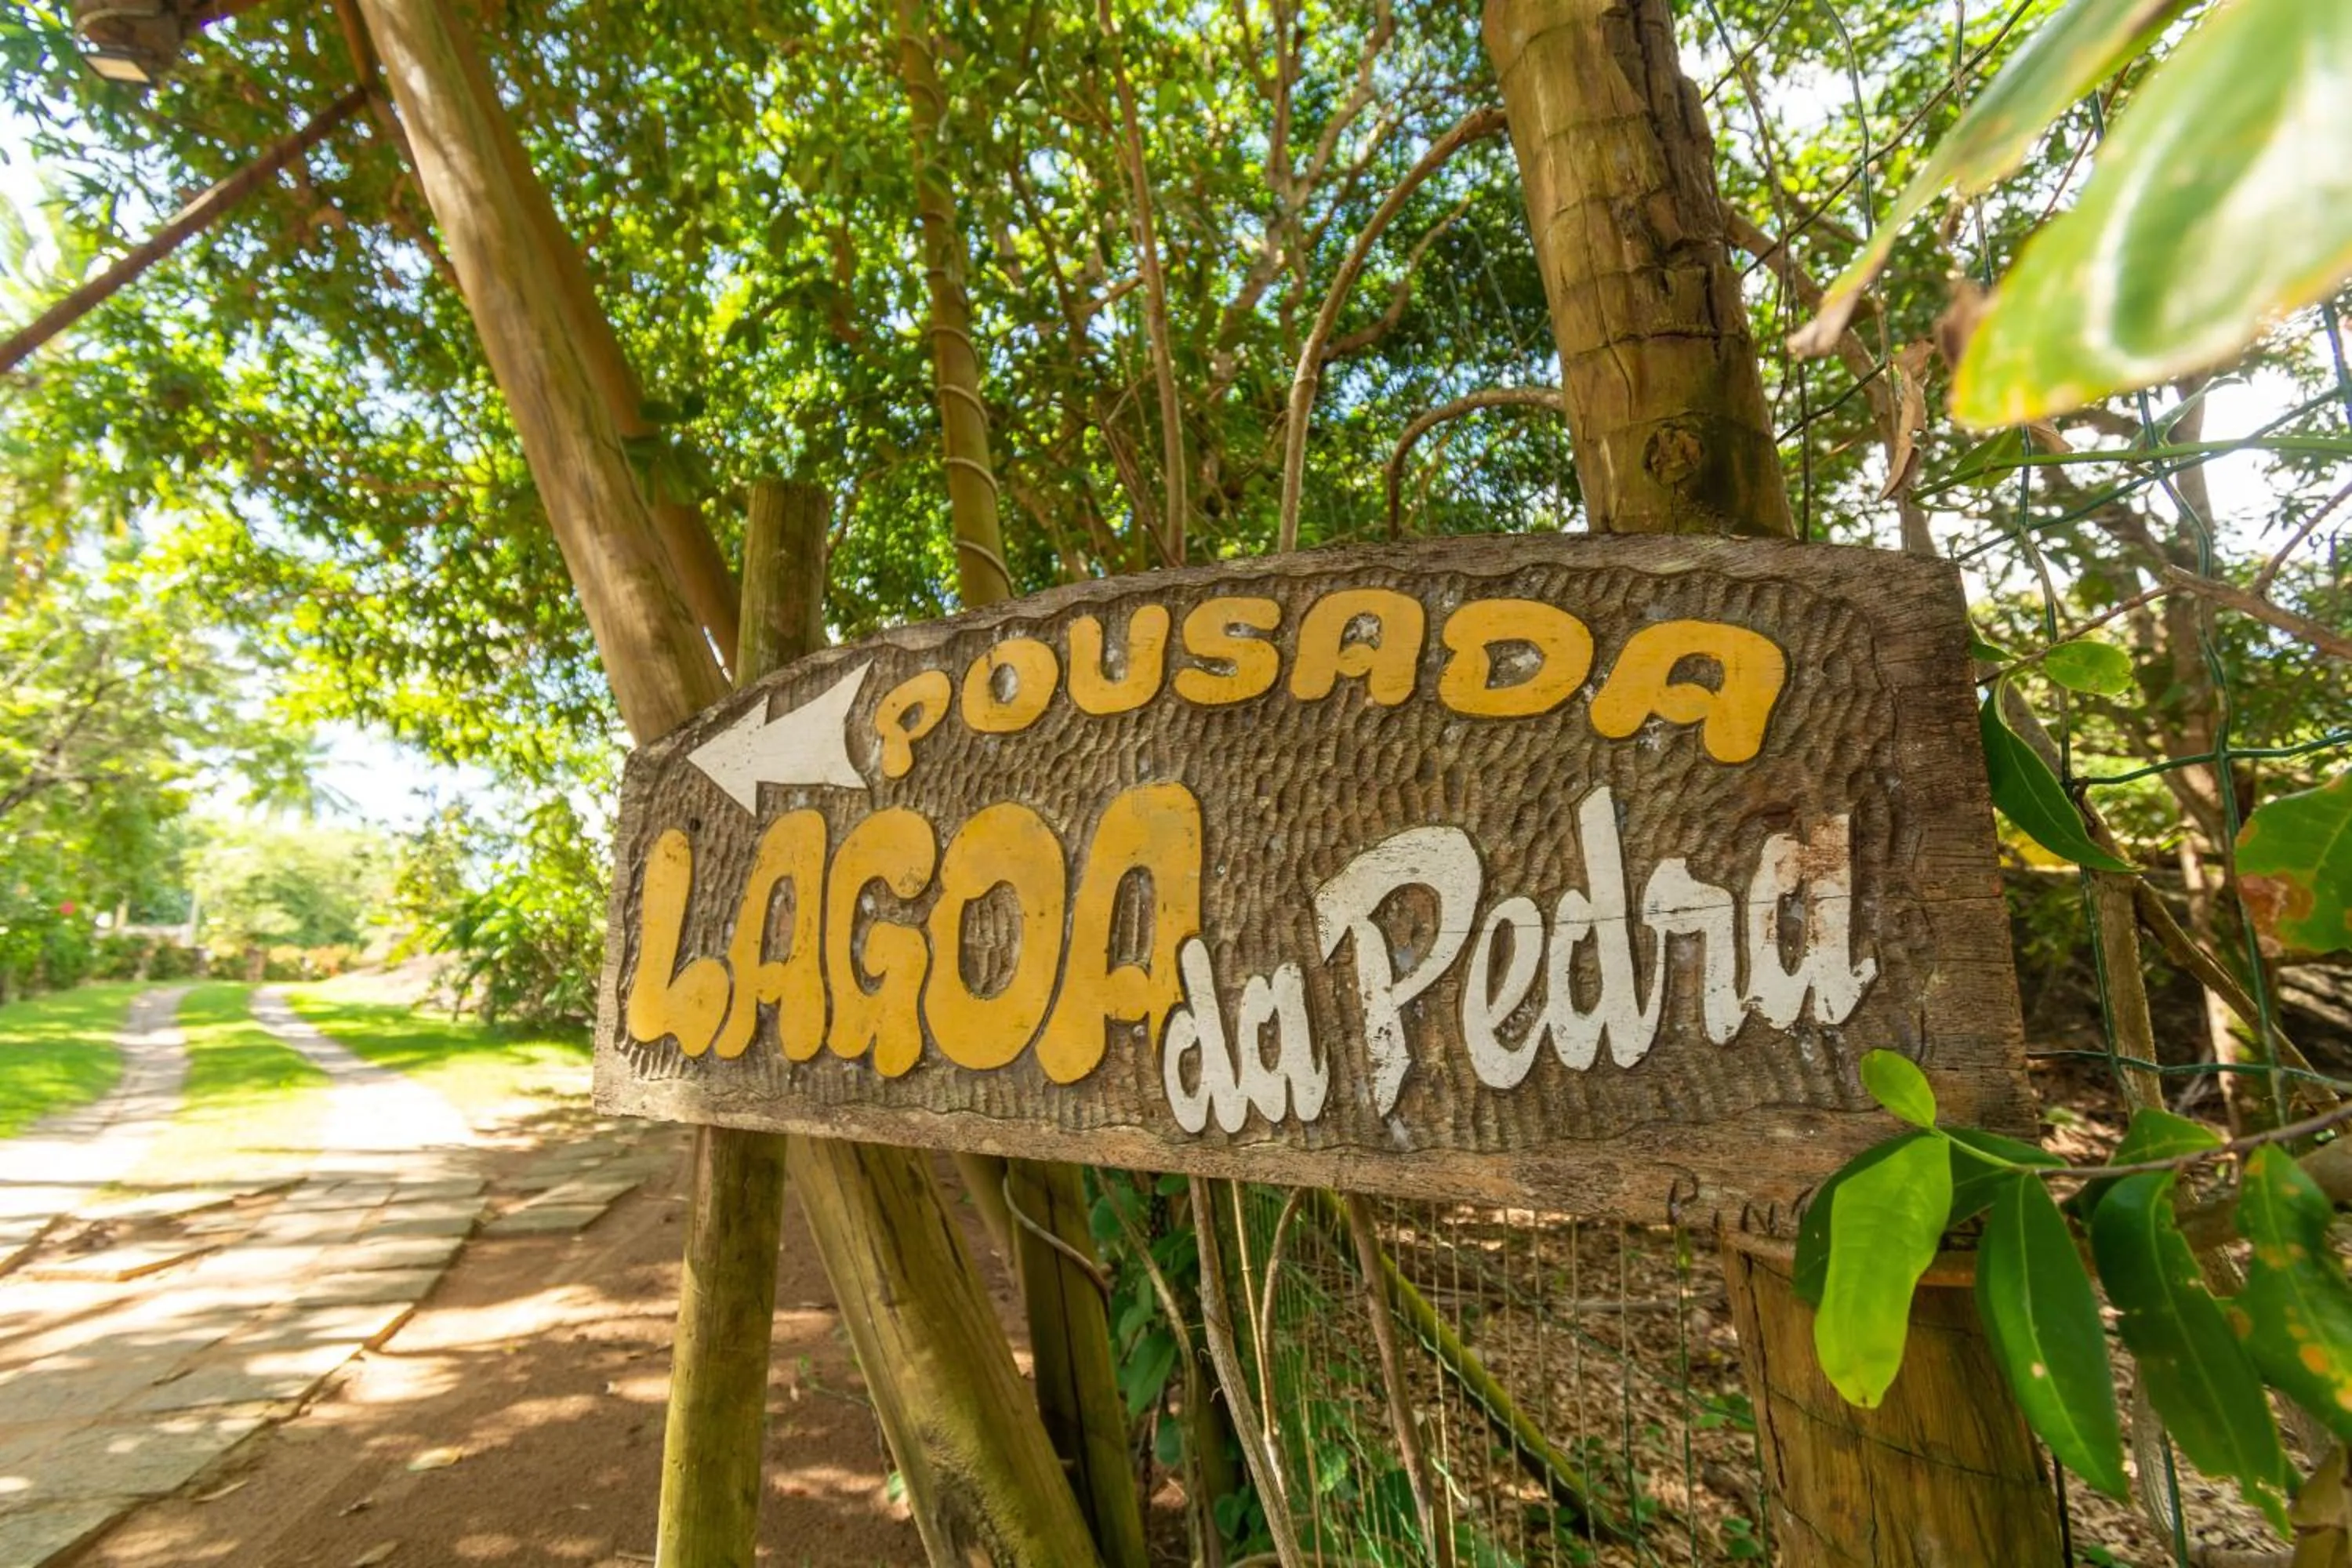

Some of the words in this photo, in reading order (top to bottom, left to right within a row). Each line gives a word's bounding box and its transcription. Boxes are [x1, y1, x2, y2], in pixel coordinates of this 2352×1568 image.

[874, 588, 1786, 779] POUSADA
[627, 783, 1203, 1082] LAGOA
[1163, 938, 1330, 1132] da
[1314, 786, 1878, 1117] Pedra
